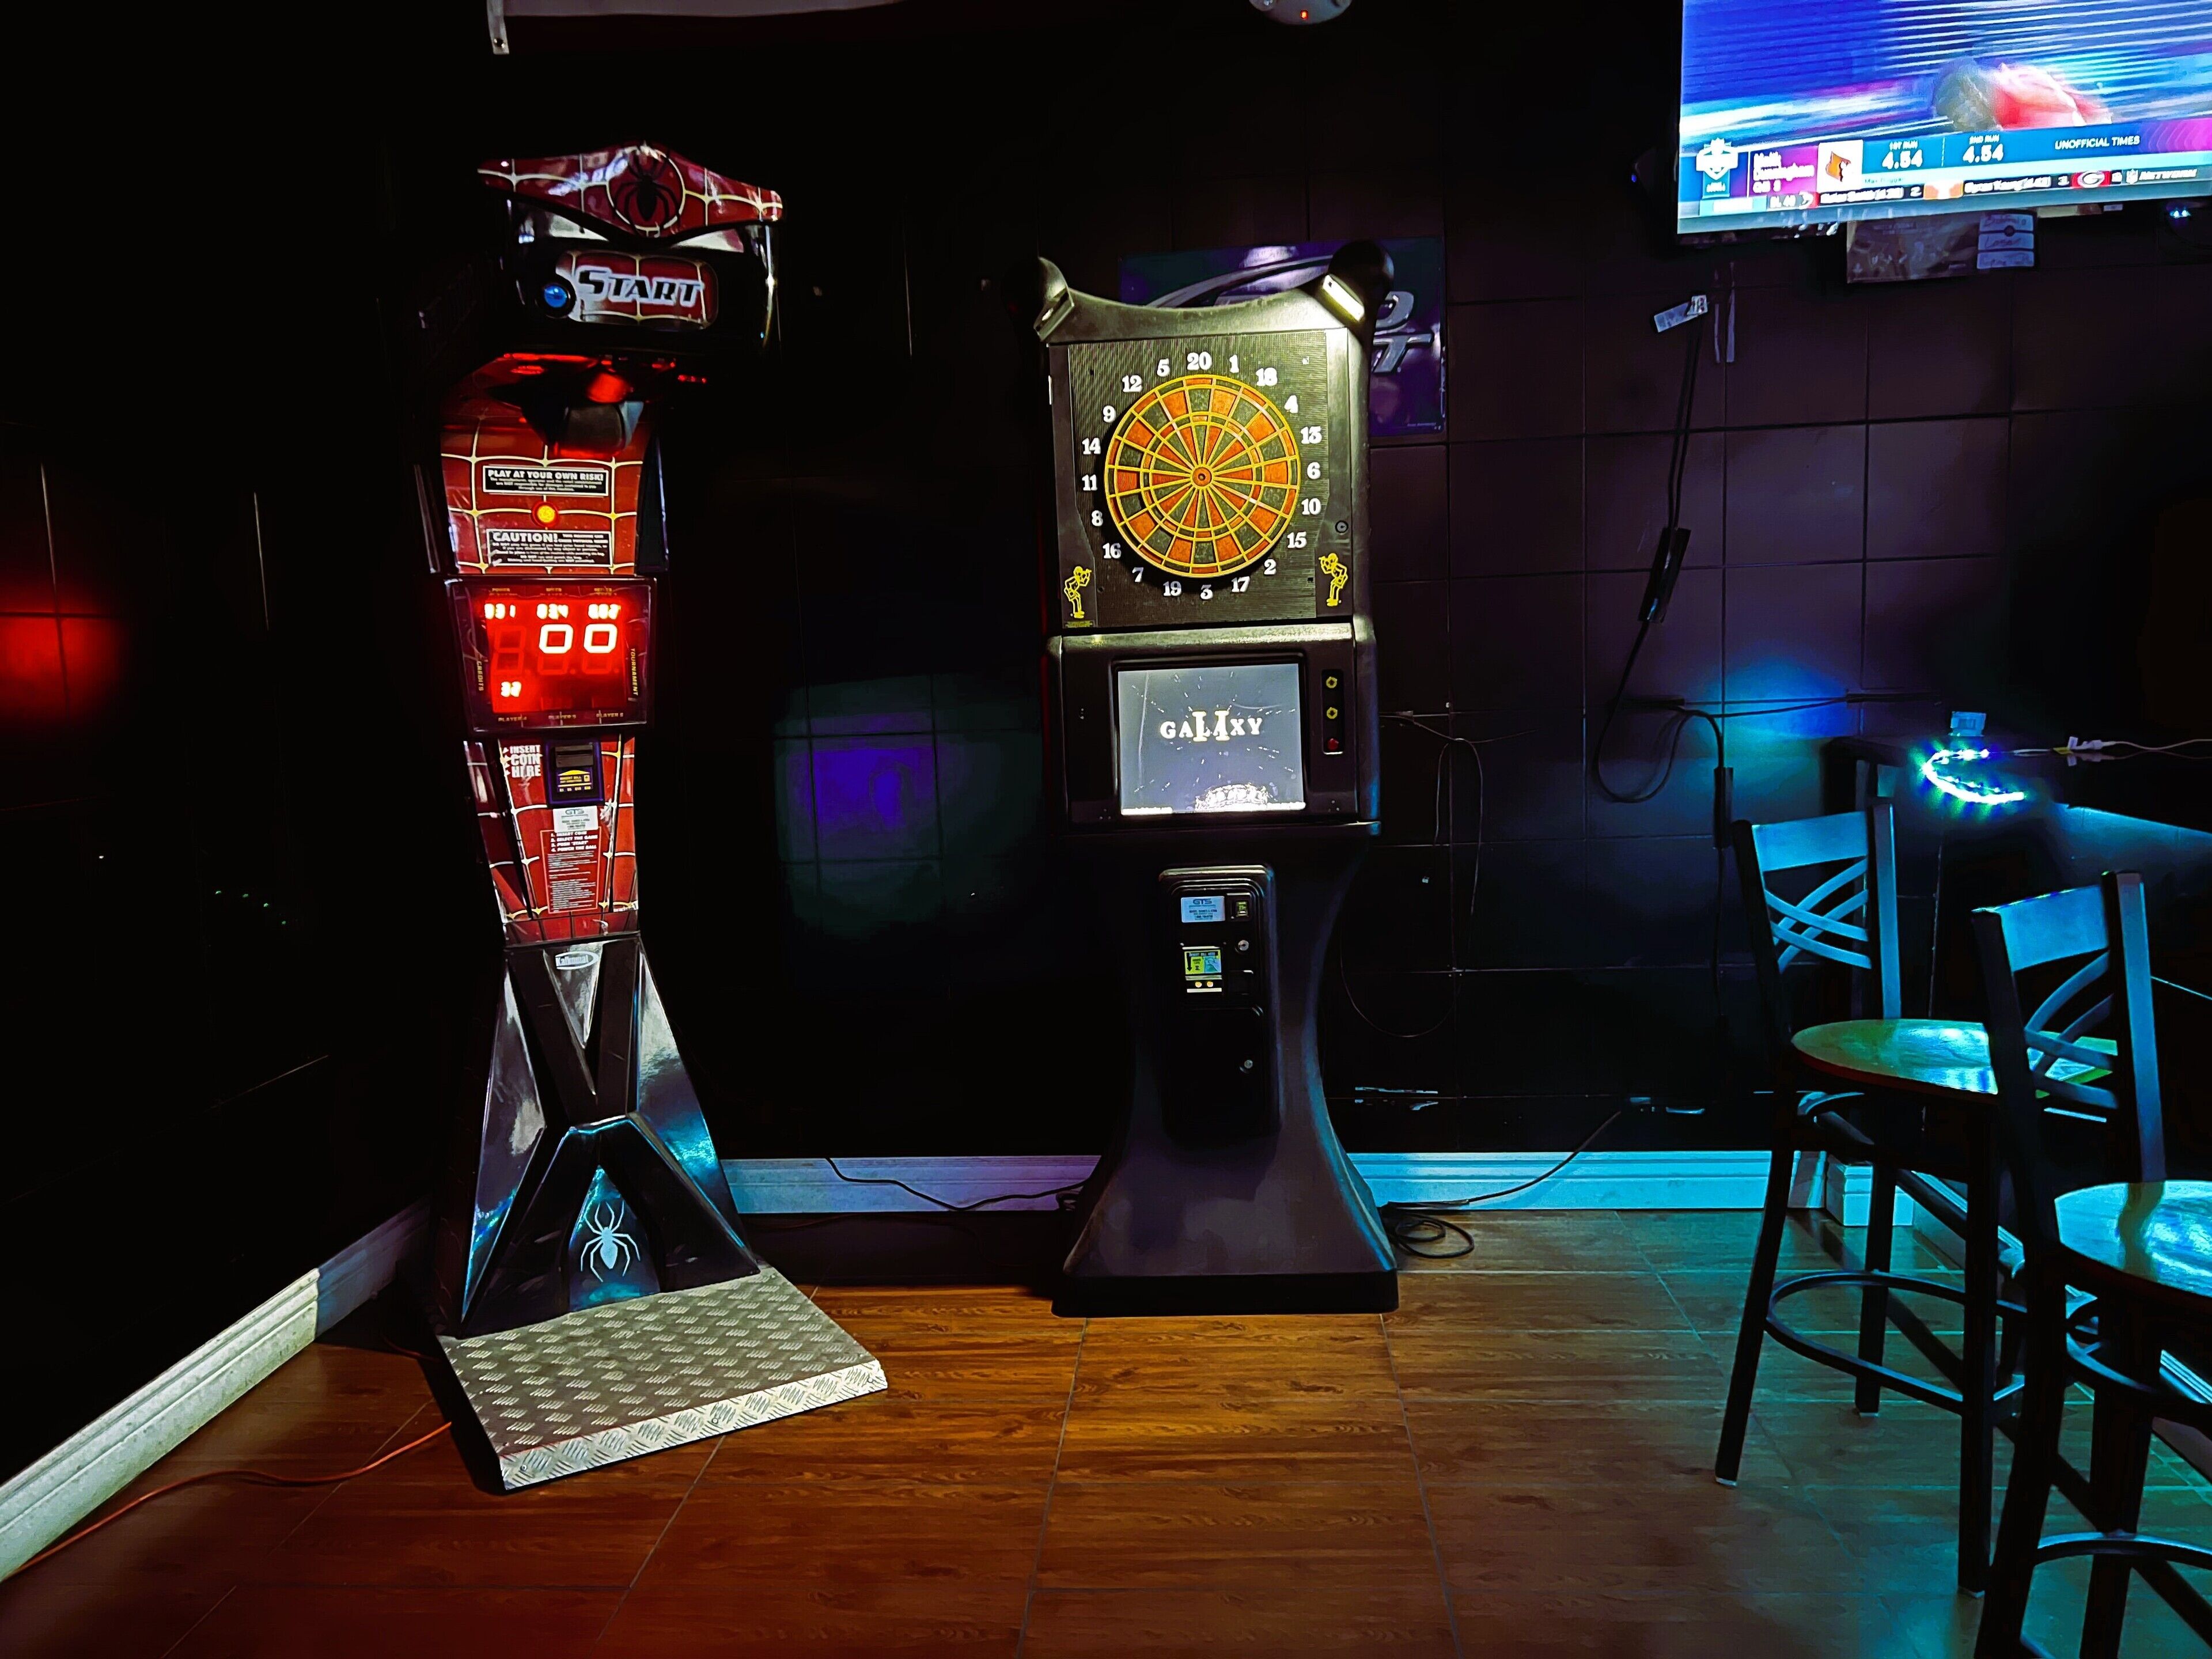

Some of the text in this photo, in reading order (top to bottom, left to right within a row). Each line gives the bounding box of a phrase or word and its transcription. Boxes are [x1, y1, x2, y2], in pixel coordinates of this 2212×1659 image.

[2055, 135, 2140, 150] UNOFFICIAL TIMES
[1882, 149, 1923, 169] 4.54
[1963, 143, 2003, 164] 4.54
[575, 266, 703, 306] START
[1157, 358, 1170, 377] 5
[1187, 351, 1212, 370] 20
[1229, 354, 1239, 373] 1
[1122, 375, 1142, 392] 12
[1256, 367, 1278, 386] 18
[1284, 395, 1298, 414] 4
[1103, 405, 1116, 422] 9
[1301, 426, 1322, 444] 13
[1082, 438, 1101, 454] 14
[488, 469, 511, 478] PLAY
[513, 470, 525, 478] AT
[527, 471, 553, 479] YOUR
[555, 472, 578, 480] OWN
[579, 473, 604, 481] RISK!
[1307, 462, 1321, 479] 6
[1082, 474, 1097, 491] 11
[1301, 498, 1321, 515] 10
[1091, 510, 1103, 527] 8
[493, 532, 558, 543] CAUTION!
[1287, 531, 1307, 548] 15
[1103, 543, 1122, 559] 16
[1132, 567, 1143, 582] 7
[1263, 558, 1277, 575] 2
[1163, 581, 1181, 596] 19
[1200, 584, 1213, 600] 3
[1231, 576, 1251, 592] 17
[476, 661, 484, 691] CREDITS
[630, 648, 639, 696] TOURNAMENT
[1160, 717, 1263, 739] GALAXY
[510, 745, 540, 754] INSERT
[510, 753, 540, 766] COIN
[512, 765, 541, 778] HERE
